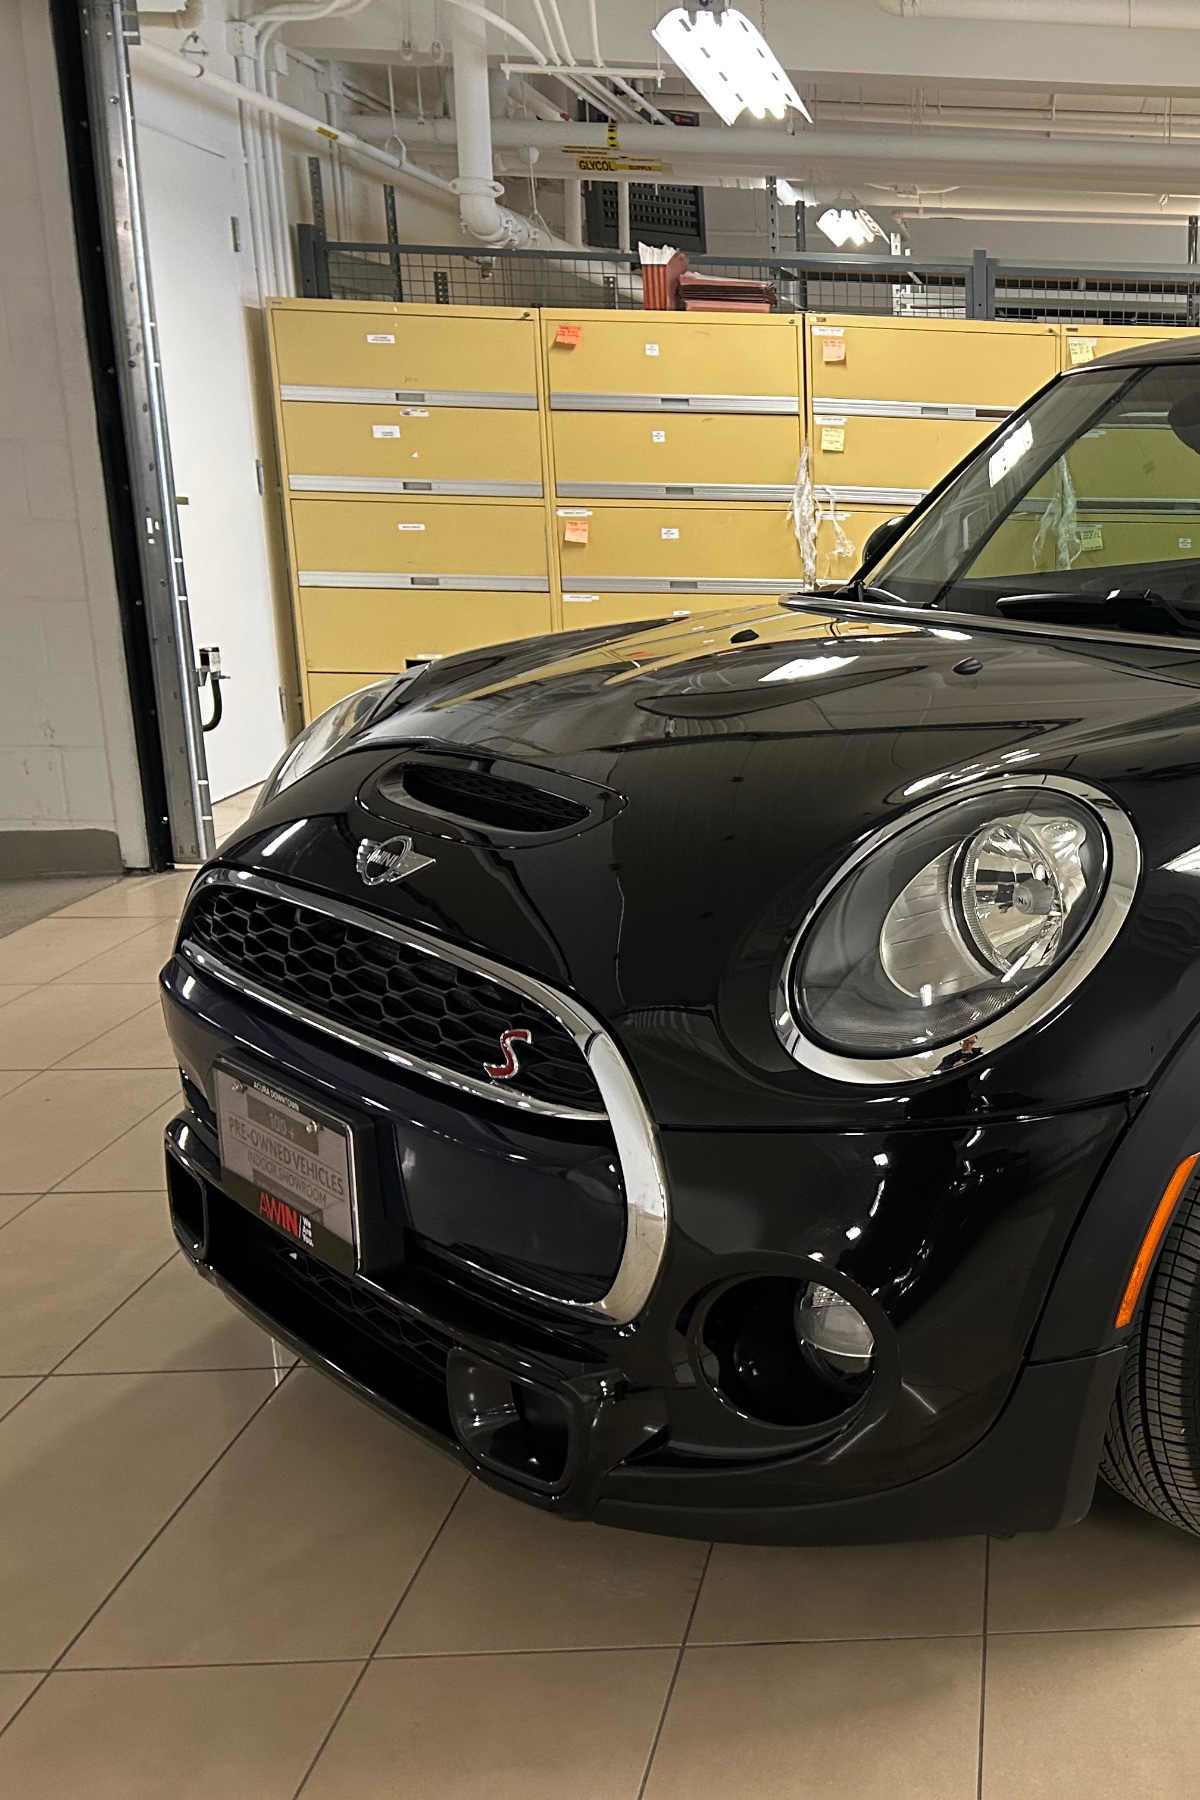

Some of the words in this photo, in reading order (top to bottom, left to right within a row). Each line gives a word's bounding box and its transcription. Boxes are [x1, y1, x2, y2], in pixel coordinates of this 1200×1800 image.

[578, 161, 615, 171] GLYCOL
[483, 1029, 531, 1079] S
[229, 1117, 291, 1165] PRE-OWNED
[291, 1149, 344, 1196] VEHICLES
[259, 1192, 299, 1238] AWIN
